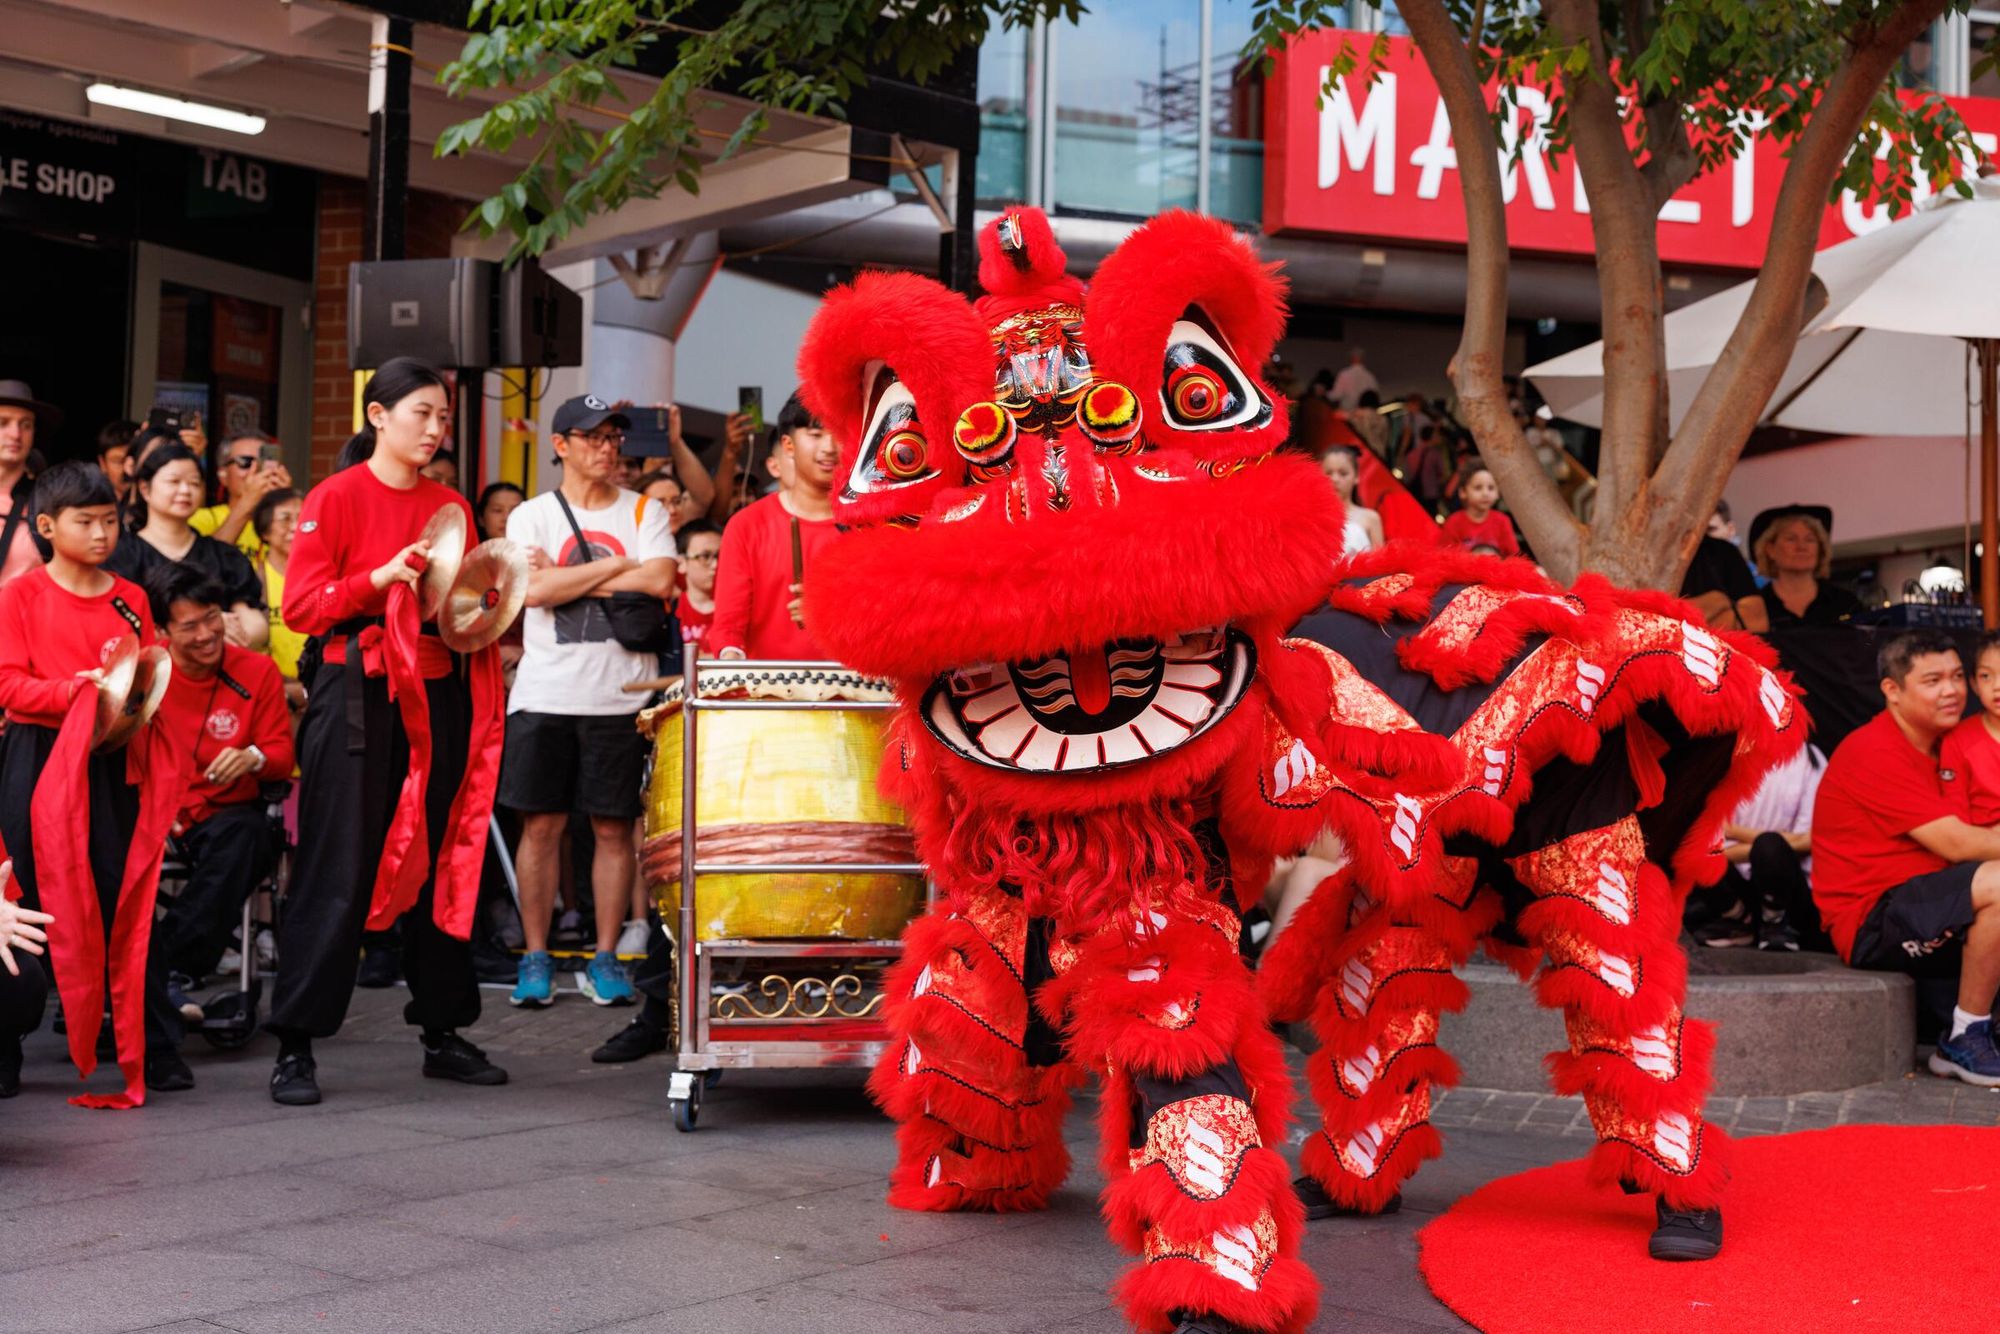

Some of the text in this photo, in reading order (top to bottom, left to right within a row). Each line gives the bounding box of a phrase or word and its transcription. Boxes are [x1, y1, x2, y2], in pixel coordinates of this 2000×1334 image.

[1317, 64, 1771, 228] MART
[36, 163, 115, 203] SHOP
[198, 150, 268, 202] TAB
